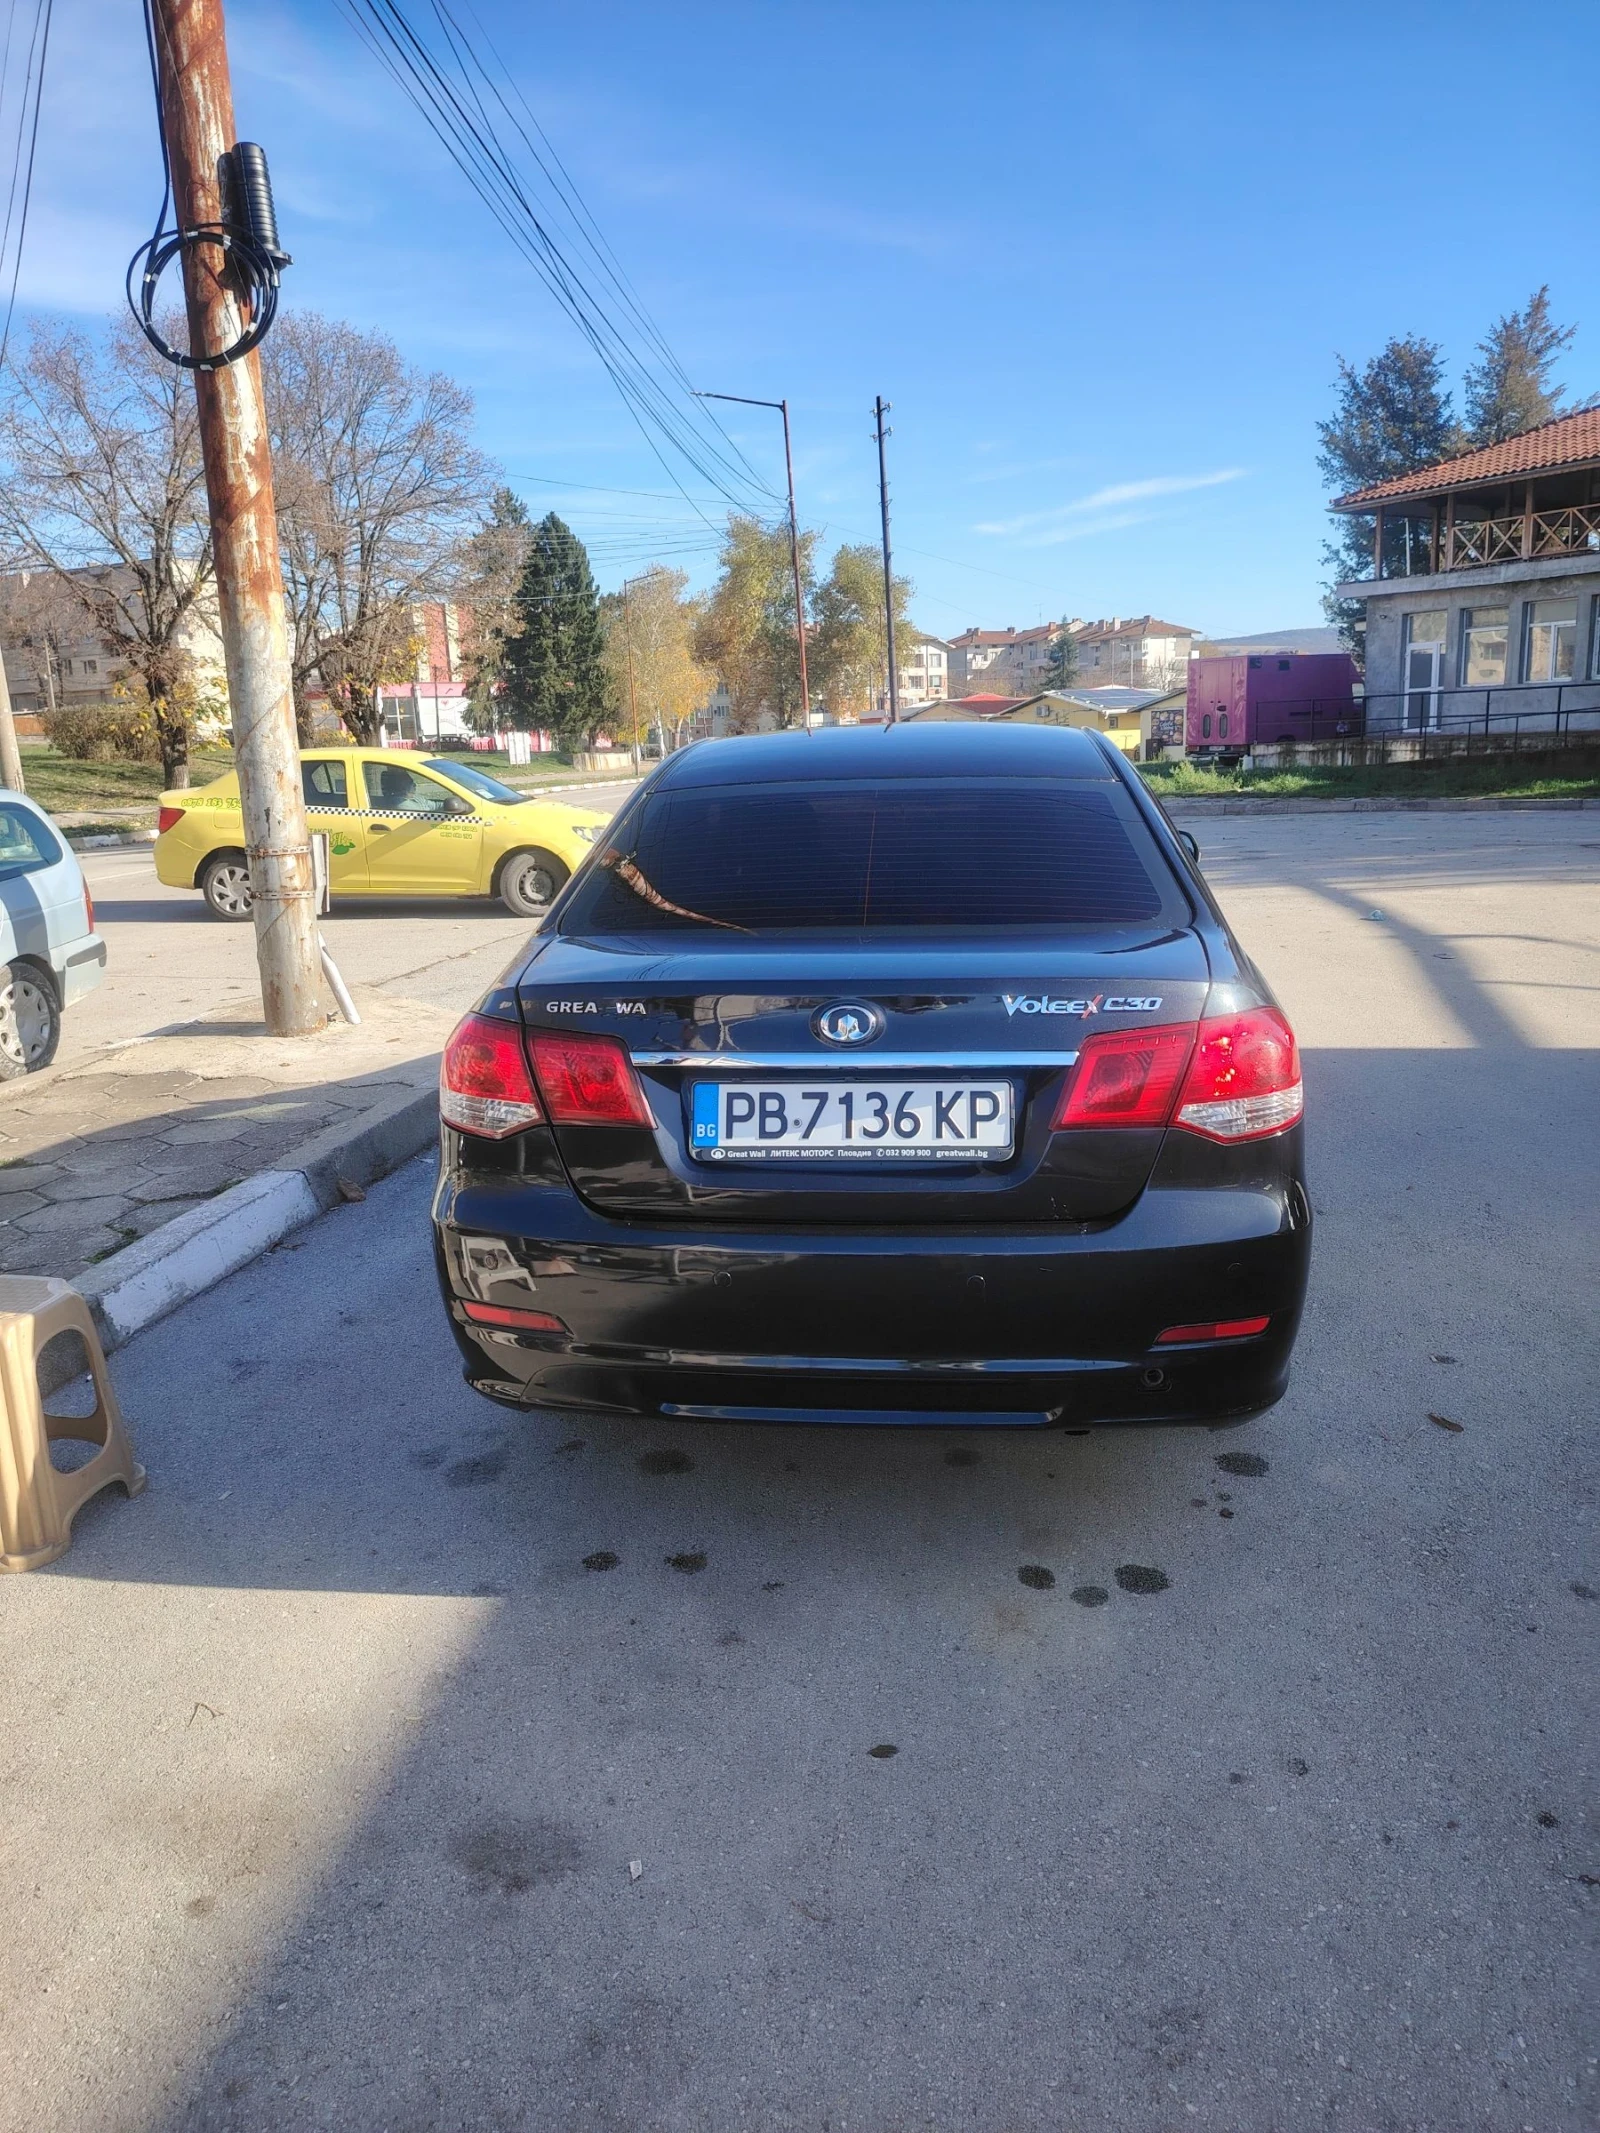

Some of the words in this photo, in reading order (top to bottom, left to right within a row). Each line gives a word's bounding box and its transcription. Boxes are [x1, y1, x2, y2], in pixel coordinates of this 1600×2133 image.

[546, 1001, 598, 1014] GREA
[615, 1002, 647, 1015] WA
[1103, 997, 1163, 1011] C30
[801, 1091, 921, 1139] 7136
[696, 1123, 717, 1138] BG
[727, 1150, 749, 1158] Great
[749, 1150, 766, 1158] Wall
[770, 1149, 800, 1157] ЛИТЕКС
[801, 1149, 834, 1157] МОТОРС
[837, 1149, 872, 1158] Пловдив
[886, 1149, 900, 1157] 032
[901, 1149, 915, 1157] 909
[916, 1149, 931, 1157] 900
[936, 1149, 988, 1159] greatwall.bg
